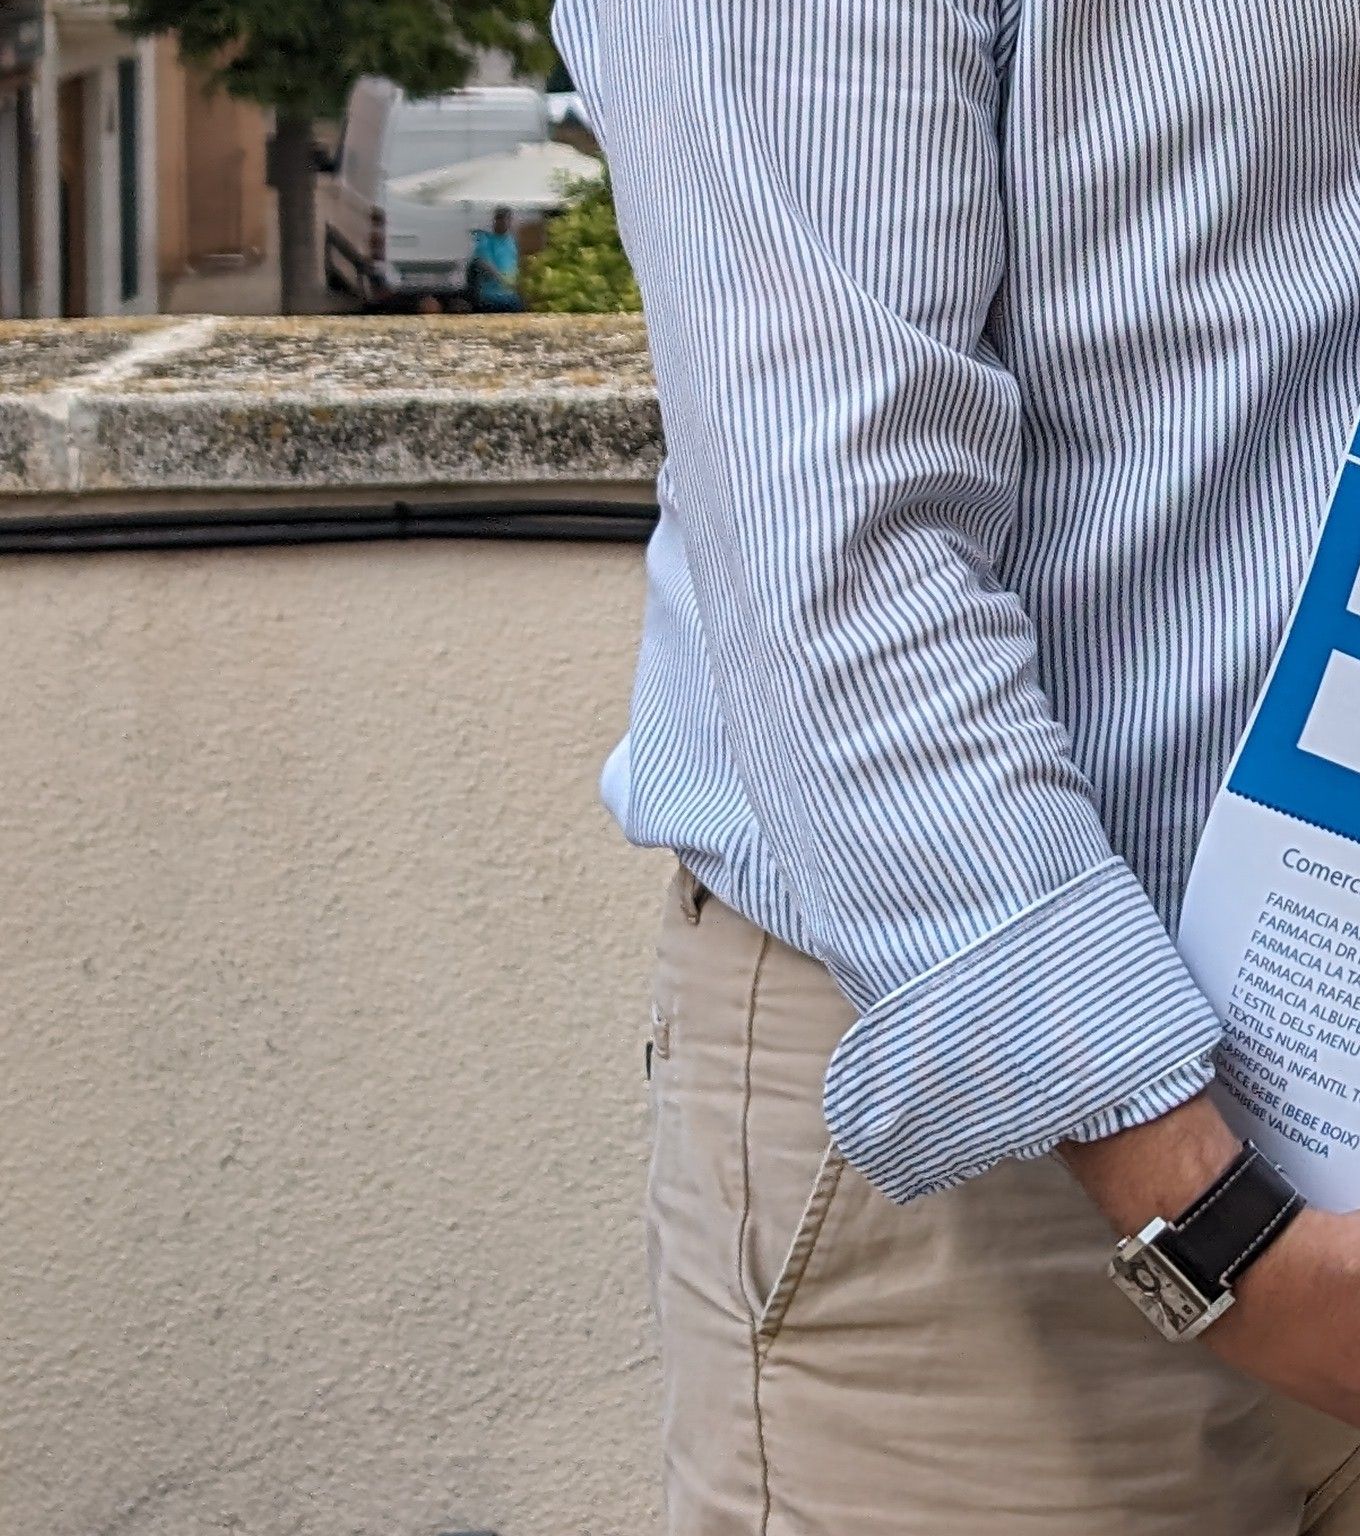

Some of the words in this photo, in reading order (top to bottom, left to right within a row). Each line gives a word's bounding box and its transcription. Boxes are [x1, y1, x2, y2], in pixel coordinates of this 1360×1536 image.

[1266, 891, 1338, 932] FARMACIA
[1251, 930, 1322, 972] FARMACIA
[1325, 962, 1343, 980] LA
[1258, 911, 1332, 952] FARMACIA
[1335, 943, 1357, 961] DR
[1238, 967, 1307, 1011] FARMACIA
[1244, 949, 1314, 991] FARMACIA
[1228, 1002, 1274, 1038] TEXTILS
[1275, 1032, 1318, 1062] NURIA
[1244, 992, 1276, 1020] ESTIL
[1280, 1012, 1315, 1037] DELS
[1222, 1019, 1284, 1068] ZAPATERIA
[1287, 1060, 1347, 1098] INFANTIL
[1268, 1114, 1329, 1158] VALENCIA
[1282, 1102, 1319, 1130] (BEBE
[1321, 1122, 1360, 1150] BOIX)
